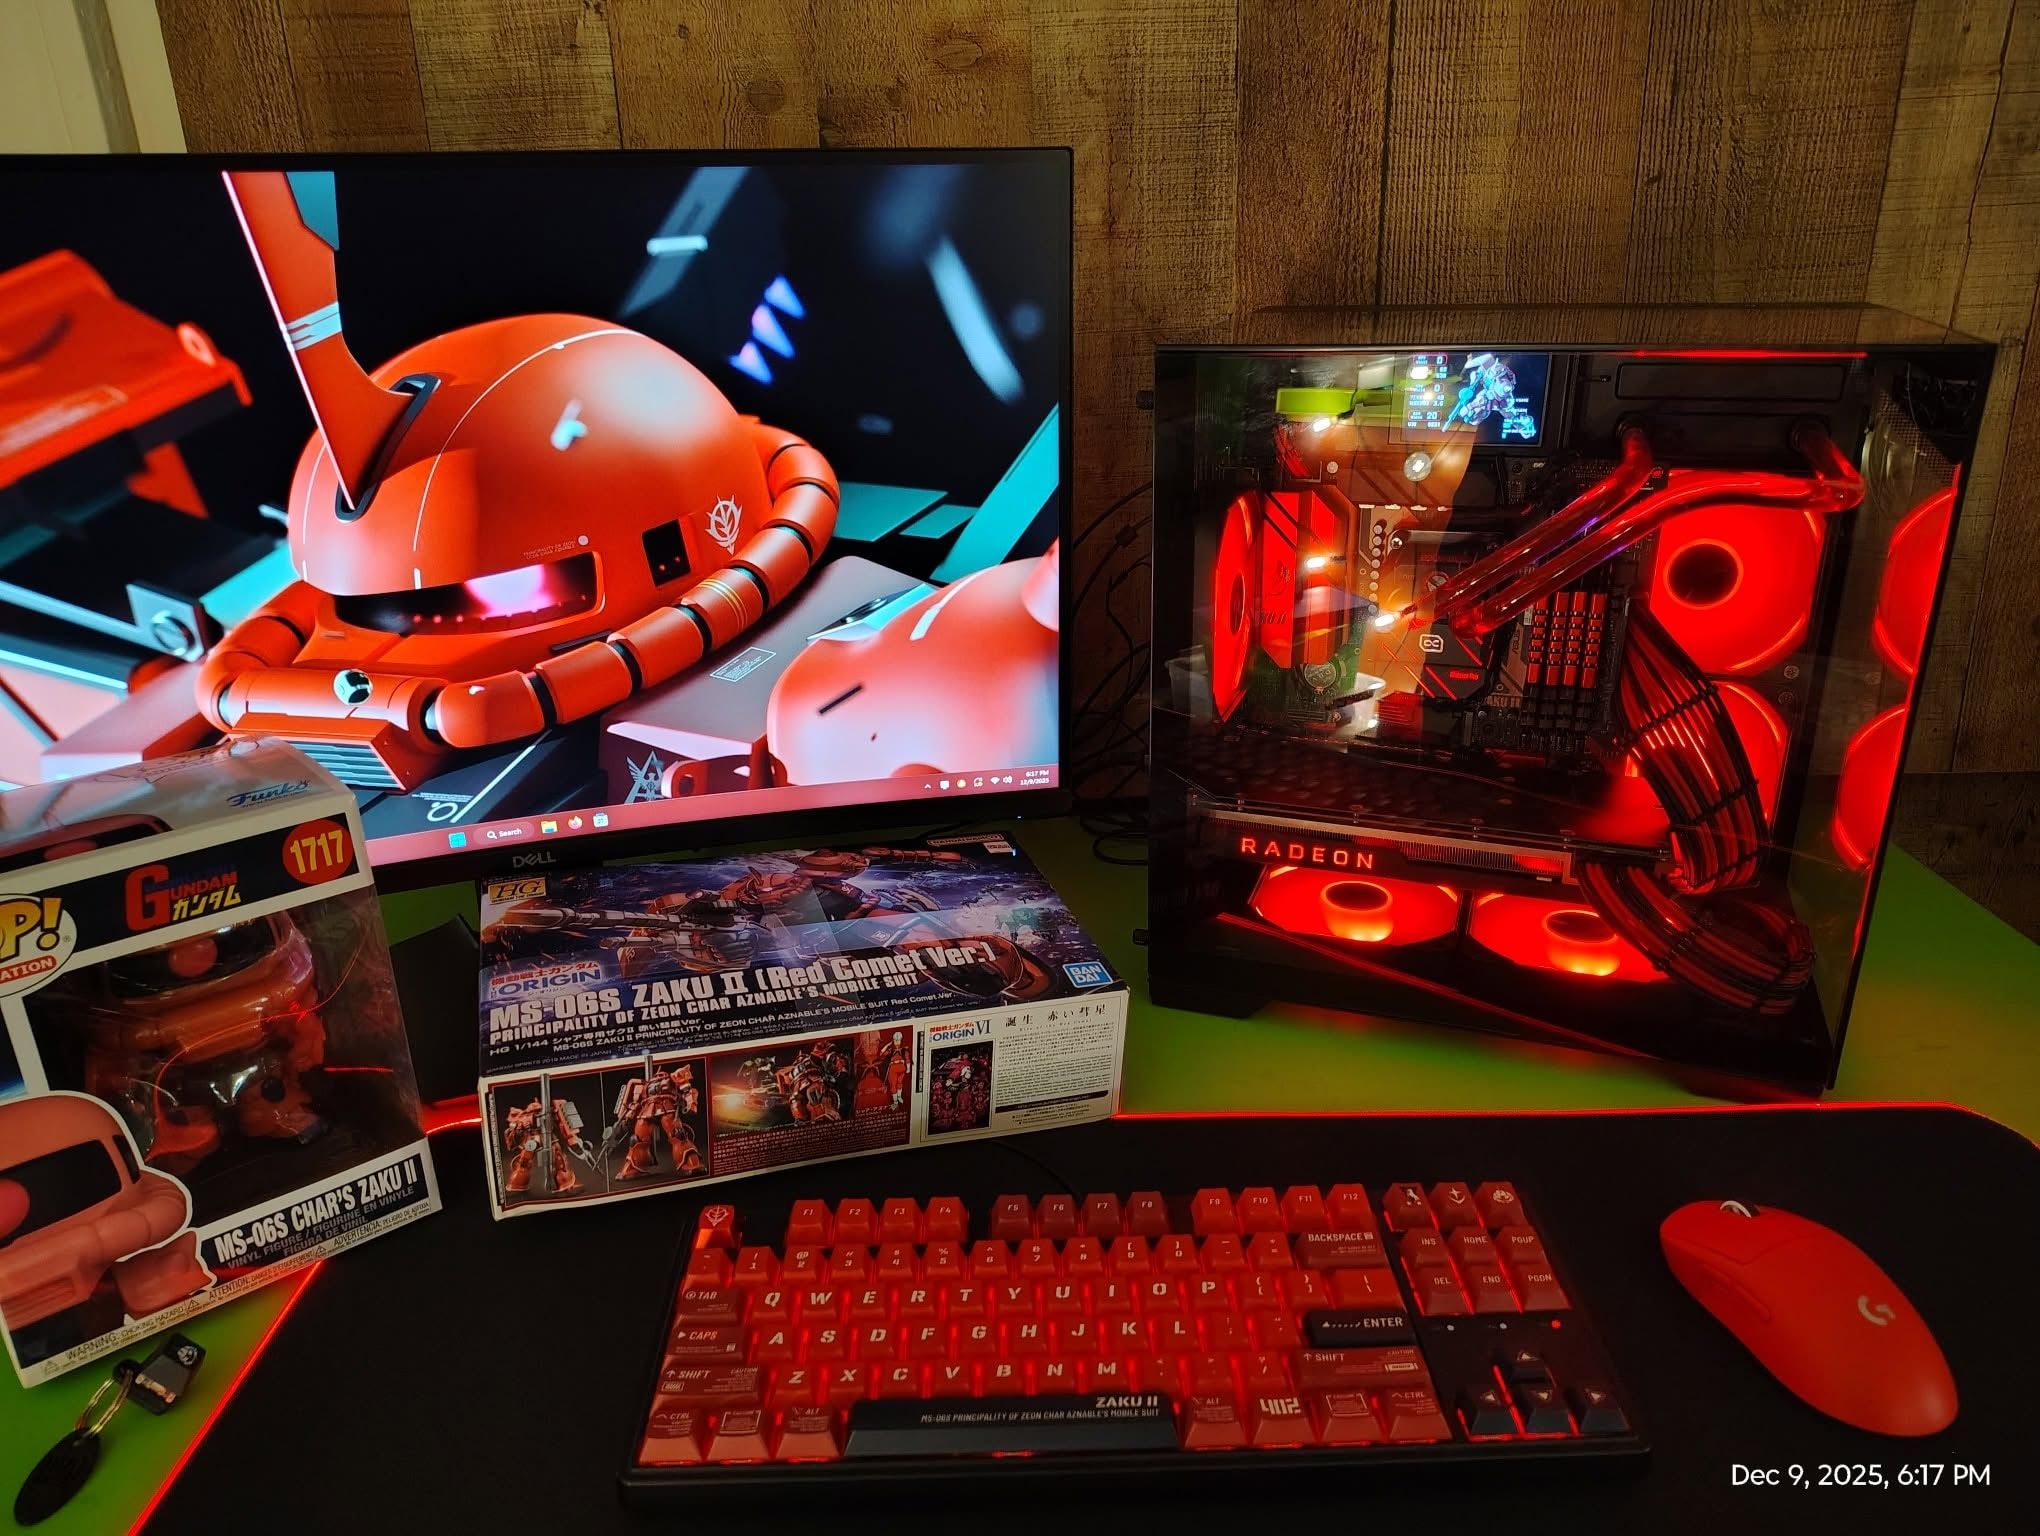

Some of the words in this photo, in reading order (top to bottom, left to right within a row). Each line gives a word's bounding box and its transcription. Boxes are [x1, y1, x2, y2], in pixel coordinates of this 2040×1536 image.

[226, 780, 310, 807] Funko
[499, 828, 523, 838] Search
[289, 829, 345, 875] 1717
[1240, 836, 1374, 870] RADEON
[512, 851, 557, 868] DELL
[496, 880, 541, 899] HG
[124, 863, 240, 934] GUNDAM
[0, 896, 63, 964] P!
[489, 987, 622, 1033] MS-06S
[631, 974, 715, 1008] ZAKU
[754, 960, 828, 991] (Red
[830, 948, 928, 981] Comet
[926, 941, 996, 968] Ver.)
[498, 970, 601, 995] ORIGIN
[489, 1013, 609, 1046] PRINCIPALITY
[615, 1009, 635, 1025] OF
[640, 1003, 682, 1021] ZEON
[686, 997, 731, 1014] CHAR
[736, 985, 819, 1008] AZNABLE'S
[822, 978, 879, 996] MOBILE
[882, 972, 919, 989] SUIT
[553, 1040, 594, 1053] MS-06S
[596, 1036, 624, 1048] ZAKU
[635, 1025, 701, 1041] PRINCIPALITY
[704, 1021, 718, 1031] OF
[719, 1018, 747, 1029] ZEON
[748, 1014, 776, 1025] CHAR
[777, 1006, 831, 1020] AZNABLE'S
[832, 1003, 866, 1014] MOBILE
[868, 999, 889, 1010] SUIT
[891, 997, 909, 1006] Red
[932, 1029, 975, 1042] ORIGIN
[976, 1019, 991, 1035] VI
[489, 1046, 510, 1057] HG
[514, 1039, 548, 1053] 1/144
[214, 1212, 290, 1264] MS-06S
[290, 1184, 356, 1231] CHAR'S
[358, 1165, 401, 1205] ZAKU
[228, 1248, 262, 1270] VINYL
[264, 1234, 303, 1254] FIGURE
[314, 1213, 361, 1235] FIGURINE
[364, 1203, 378, 1214] EN
[380, 1187, 415, 1207] VINYLE
[284, 1236, 323, 1256] FIGURA
[326, 1228, 340, 1240] DE
[341, 1217, 368, 1234] VINIL
[1308, 1233, 1366, 1241] BACKSPACE
[1009, 1288, 1021, 1299] Y
[1056, 1286, 1070, 1298] U
[1109, 1285, 1114, 1296] I
[1153, 1283, 1166, 1295] O
[1202, 1282, 1215, 1293] P
[765, 1293, 780, 1307] Q
[811, 1292, 832, 1304] W
[863, 1292, 876, 1303] E
[911, 1291, 925, 1302] R
[960, 1289, 972, 1301] T
[1122, 1322, 1136, 1334] K
[1175, 1321, 1185, 1334] L
[1364, 1317, 1402, 1327] ENTER
[690, 1331, 717, 1340] CAPS
[870, 1329, 886, 1341] D
[921, 1328, 935, 1339] F
[972, 1326, 986, 1338] G
[1022, 1325, 1037, 1337] H
[1072, 1324, 1084, 1336] J
[769, 1332, 783, 1344] A
[821, 1331, 835, 1342] S
[1315, 1353, 1345, 1361] SHIFT
[679, 1370, 710, 1378] SHIFT
[893, 1369, 908, 1380] C
[946, 1367, 960, 1378] V
[997, 1365, 1011, 1376] B
[1048, 1364, 1062, 1376] N
[1098, 1363, 1116, 1374] M
[789, 1371, 804, 1383] Z
[840, 1369, 856, 1381] X
[1096, 1397, 1142, 1408] ZAKU
[805, 1407, 823, 1415] ALT
[953, 1412, 1006, 1421] PRINCIPALITY
[1009, 1412, 1019, 1420] OF
[1021, 1411, 1042, 1420] ZEON
[1044, 1411, 1065, 1419] CHAR
[1111, 1409, 1139, 1417] MOBILE
[1141, 1408, 1159, 1417] SUIT
